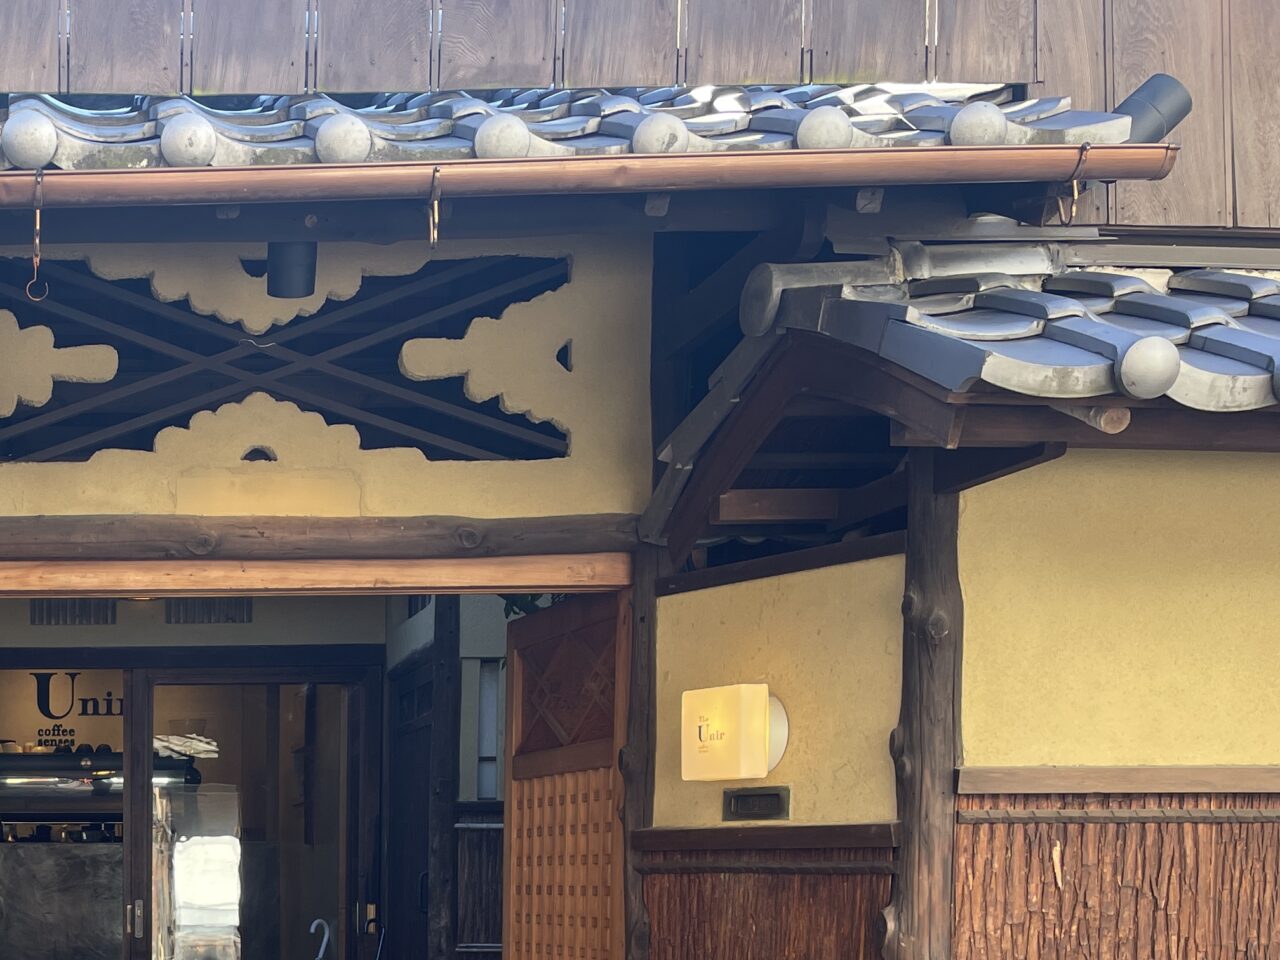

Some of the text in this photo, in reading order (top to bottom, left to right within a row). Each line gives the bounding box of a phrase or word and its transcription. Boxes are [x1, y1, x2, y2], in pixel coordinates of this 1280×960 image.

[37, 723, 75, 737] coffee
[697, 723, 725, 743] Unir
[37, 738, 75, 747] senses
